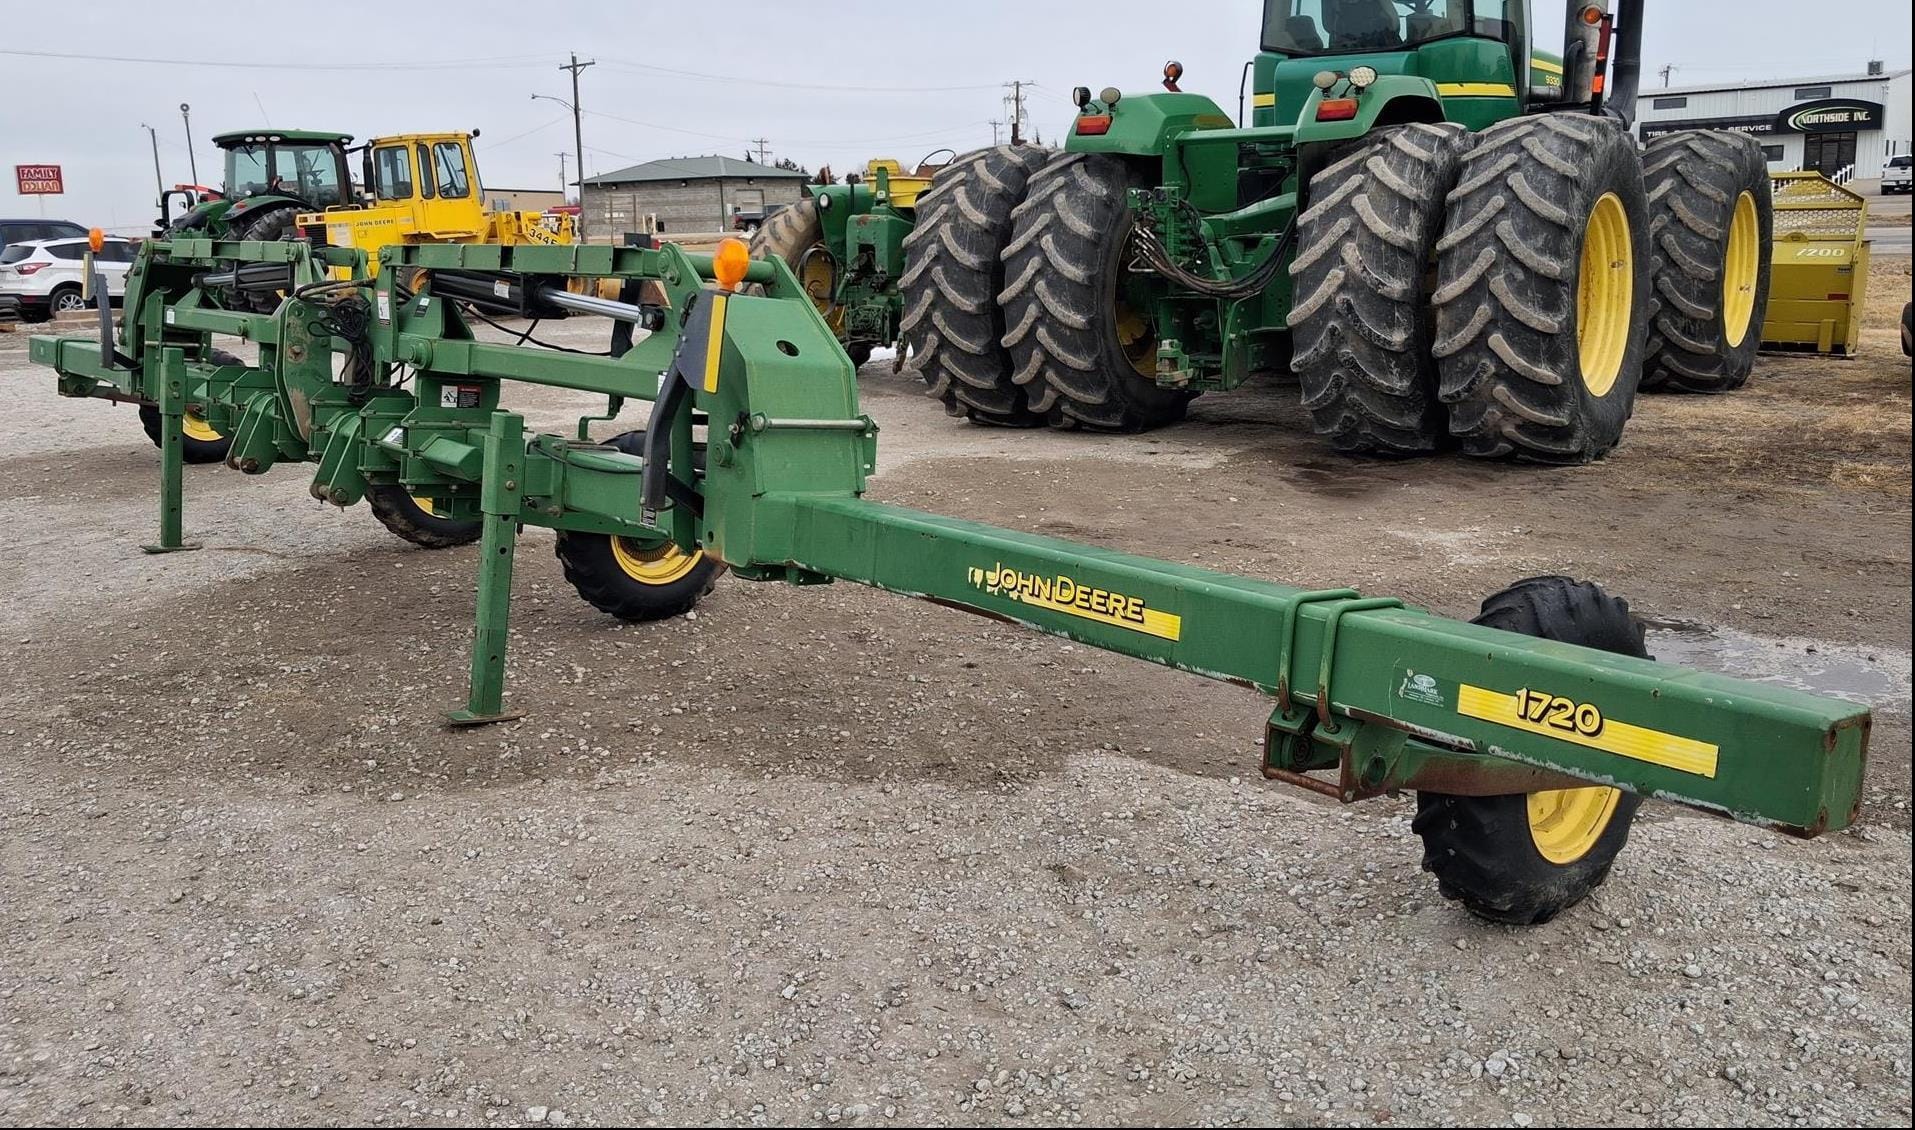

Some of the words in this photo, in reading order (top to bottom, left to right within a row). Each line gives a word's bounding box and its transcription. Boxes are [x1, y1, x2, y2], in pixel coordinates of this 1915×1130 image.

[1800, 112, 1849, 124] NORTHSIDE
[1853, 111, 1871, 121] INC.
[1728, 124, 1773, 133] SERVICE
[20, 168, 57, 179] FAMILY
[986, 562, 1051, 600] JOHN
[1054, 575, 1145, 623] DEERE
[1515, 687, 1604, 737] 1720
